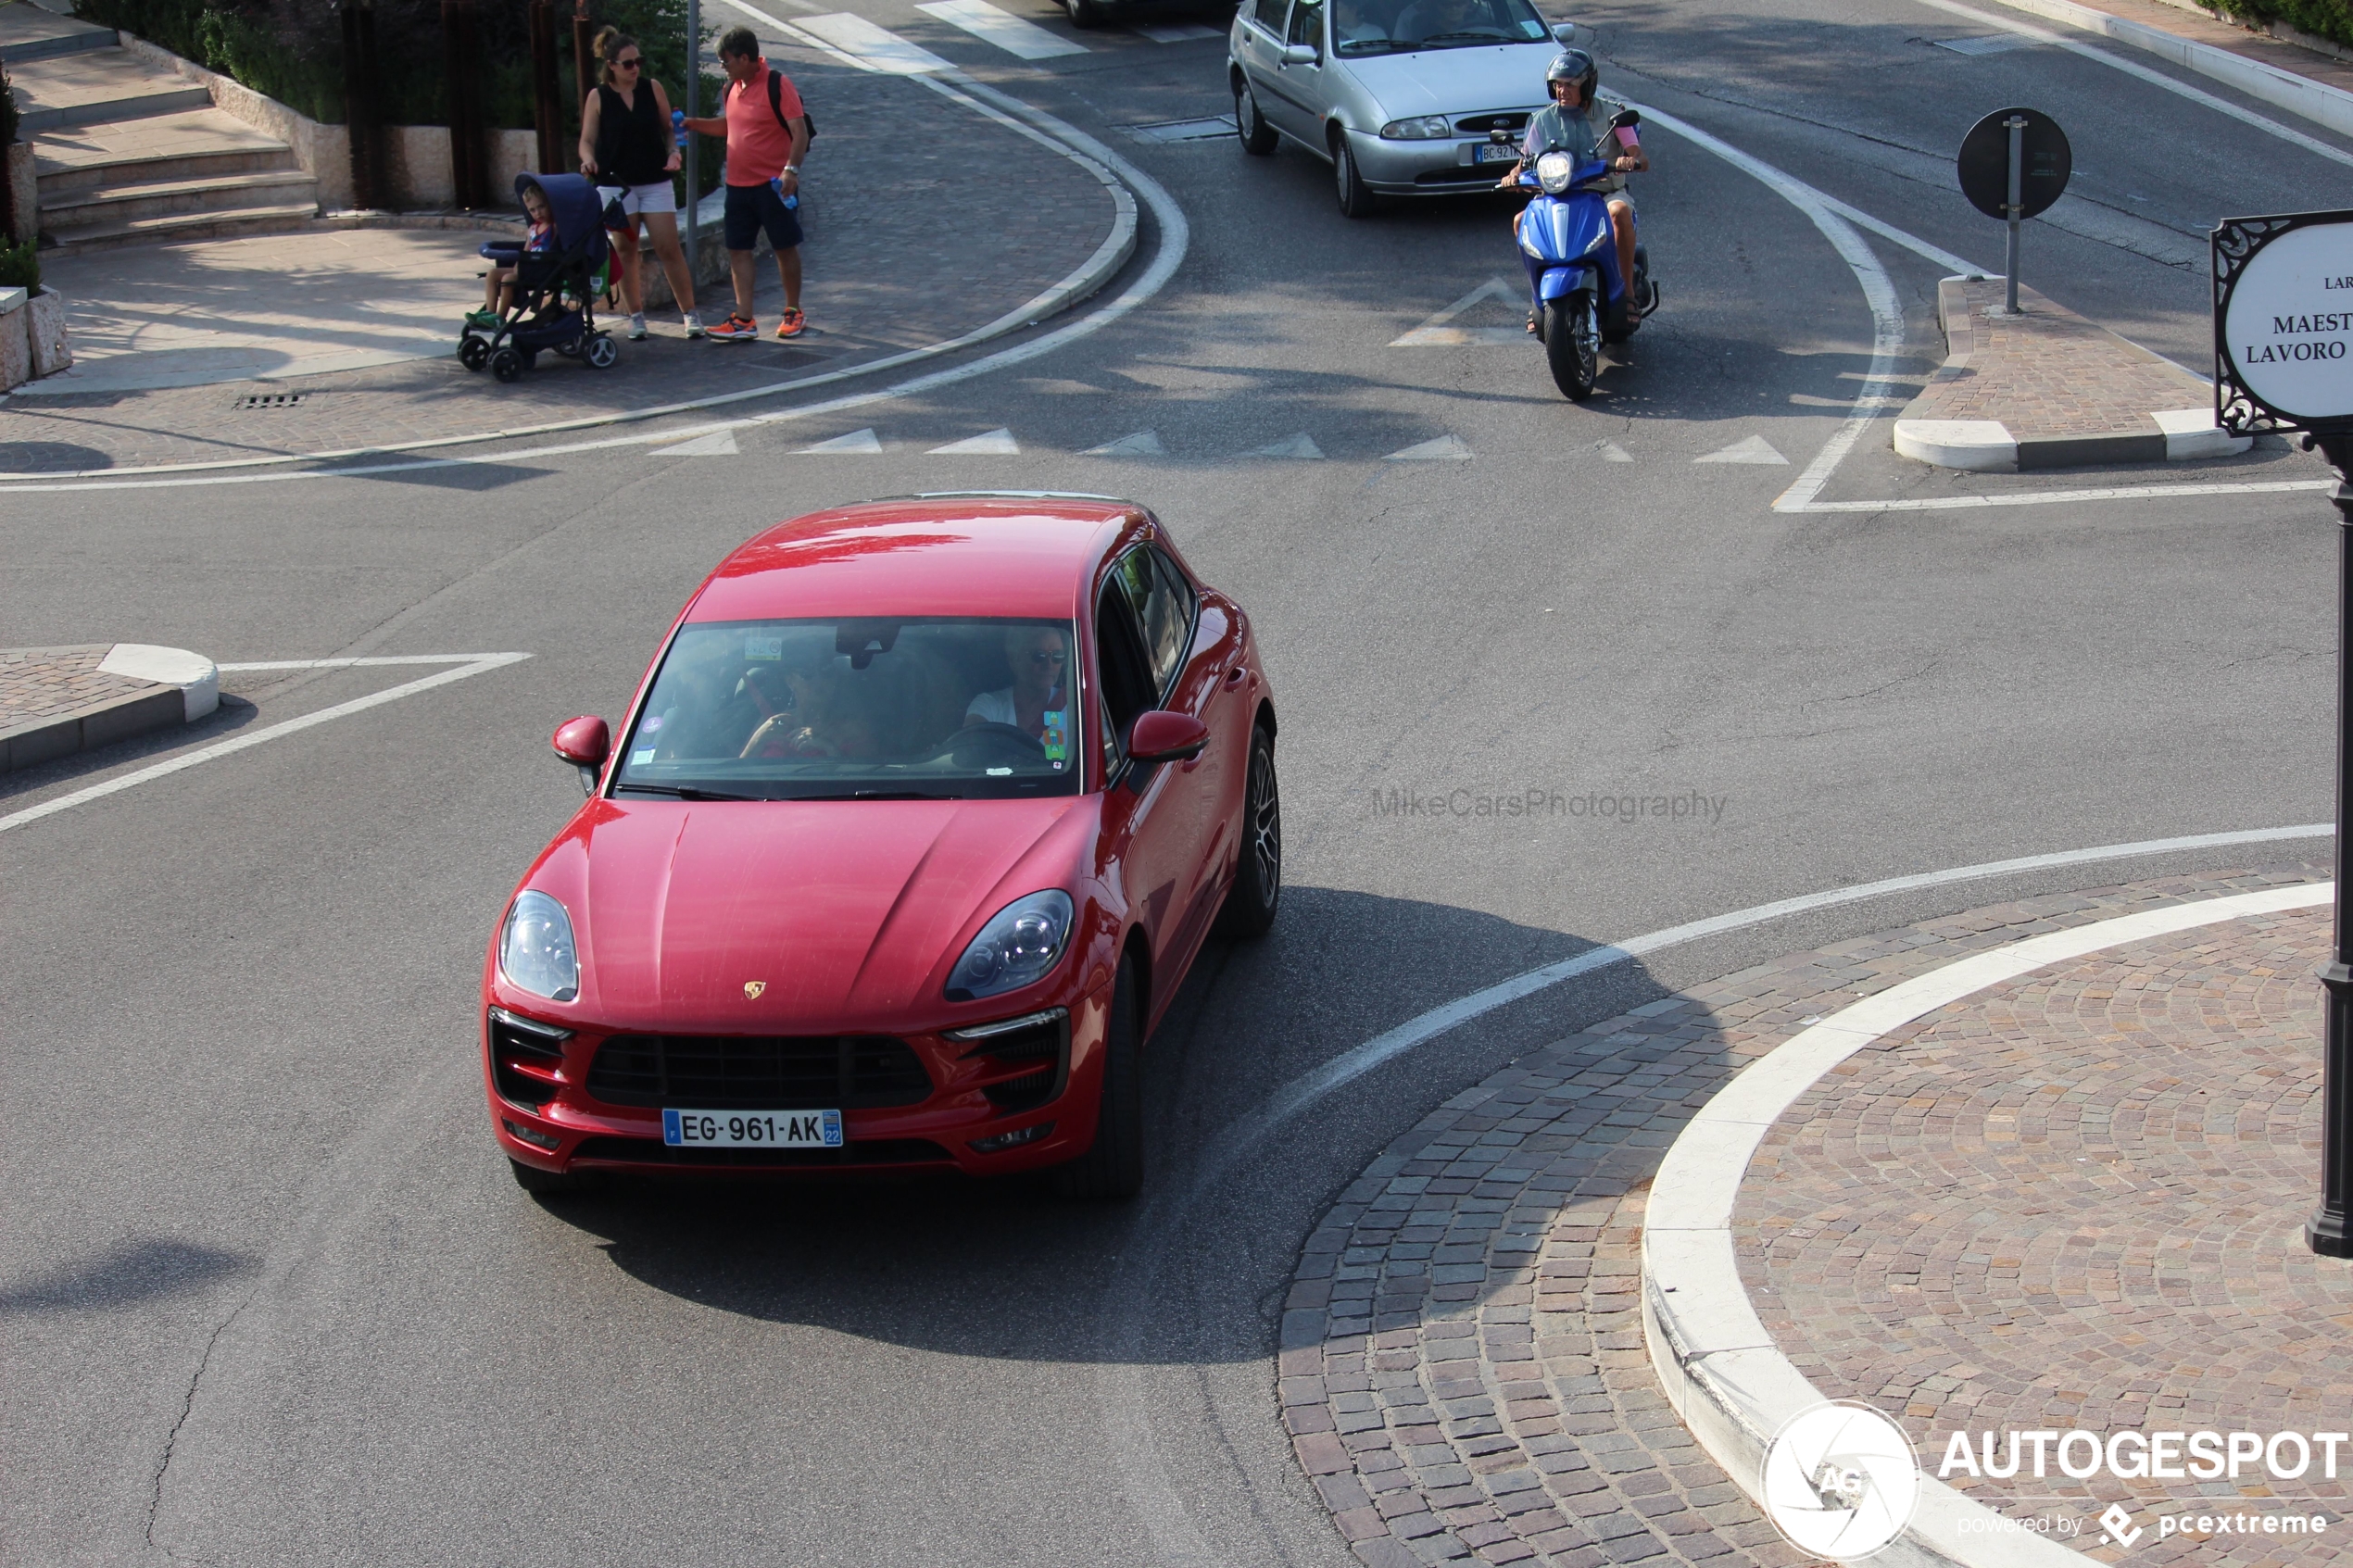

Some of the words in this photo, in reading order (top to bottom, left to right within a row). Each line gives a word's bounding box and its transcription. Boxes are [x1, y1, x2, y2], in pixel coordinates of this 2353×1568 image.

[2273, 313, 2353, 334] MAEST
[2246, 341, 2346, 363] LAVORO
[671, 1130, 677, 1139] F
[825, 1130, 840, 1143] 22
